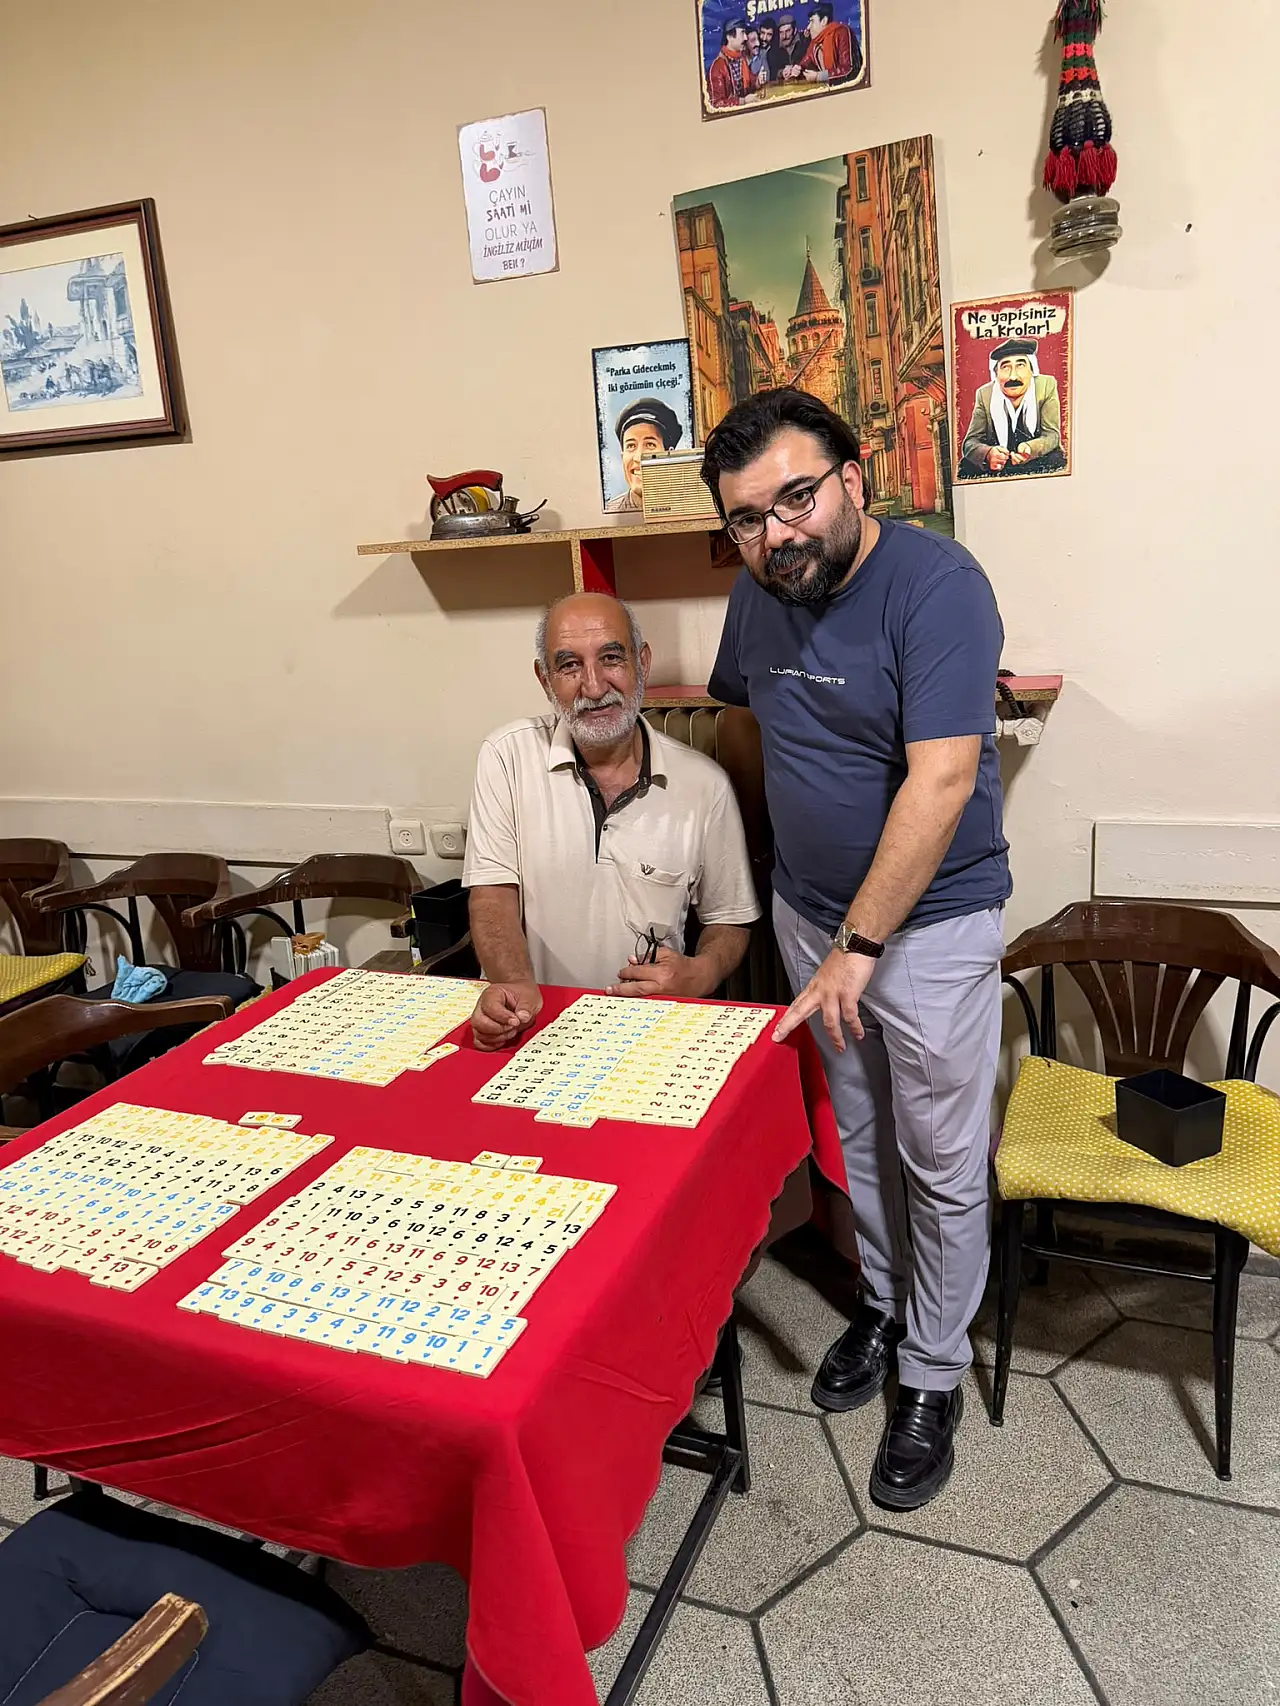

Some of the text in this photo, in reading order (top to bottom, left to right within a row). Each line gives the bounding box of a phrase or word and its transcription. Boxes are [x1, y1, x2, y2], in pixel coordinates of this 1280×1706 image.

[489, 184, 525, 207] ÇAYIN
[486, 200, 531, 221] SAATİ Mİ
[485, 221, 538, 241] OLUR YA
[484, 241, 514, 258] İNGİLİZ
[502, 258, 518, 270] BEN
[968, 307, 1056, 326] Ne yapisiniz
[976, 327, 992, 339] La
[632, 362, 676, 374] Gidecekmiş
[620, 380, 654, 393] gözümün
[349, 1190, 366, 1198] 13
[453, 1208, 468, 1216] 11
[475, 1211, 487, 1219] 8
[497, 1214, 510, 1222] 3
[522, 1217, 530, 1225] 1
[544, 1220, 556, 1228] 7
[564, 1224, 581, 1233] 13
[327, 1208, 342, 1217] 11
[345, 1212, 362, 1220] 10
[408, 1223, 425, 1232] 10
[429, 1226, 446, 1236] 12
[453, 1231, 465, 1239] 6
[475, 1233, 488, 1242] 8
[496, 1236, 514, 1246] 12
[521, 1241, 533, 1250] 4
[543, 1245, 557, 1254] 5
[286, 1222, 300, 1230] 2
[305, 1227, 319, 1235] 7
[325, 1232, 338, 1240] 4
[344, 1236, 360, 1246] 11
[366, 1240, 380, 1248] 6
[386, 1243, 404, 1253] 13
[409, 1246, 426, 1258] 11
[433, 1252, 446, 1260] 6
[455, 1256, 468, 1265] 9
[477, 1258, 496, 1269] 12
[500, 1262, 520, 1272] 13
[528, 1267, 540, 1276] 7
[262, 1242, 276, 1250] 4
[280, 1247, 294, 1256] 3
[300, 1252, 317, 1261] 10
[323, 1258, 334, 1266] 1
[341, 1261, 356, 1270] 5
[363, 1266, 378, 1276] 2
[384, 1270, 403, 1281] 12
[409, 1274, 425, 1283] 5
[433, 1279, 447, 1288] 3
[458, 1282, 471, 1291] 8
[480, 1285, 499, 1296] 10
[510, 1291, 519, 1301] 1
[228, 1262, 516, 1330] 7 8 10 8 6 13 7 11 12 2 12 2 5
[199, 1287, 493, 1358] 4 13 9 6 3 5 4 3 11 9 10 1 1
